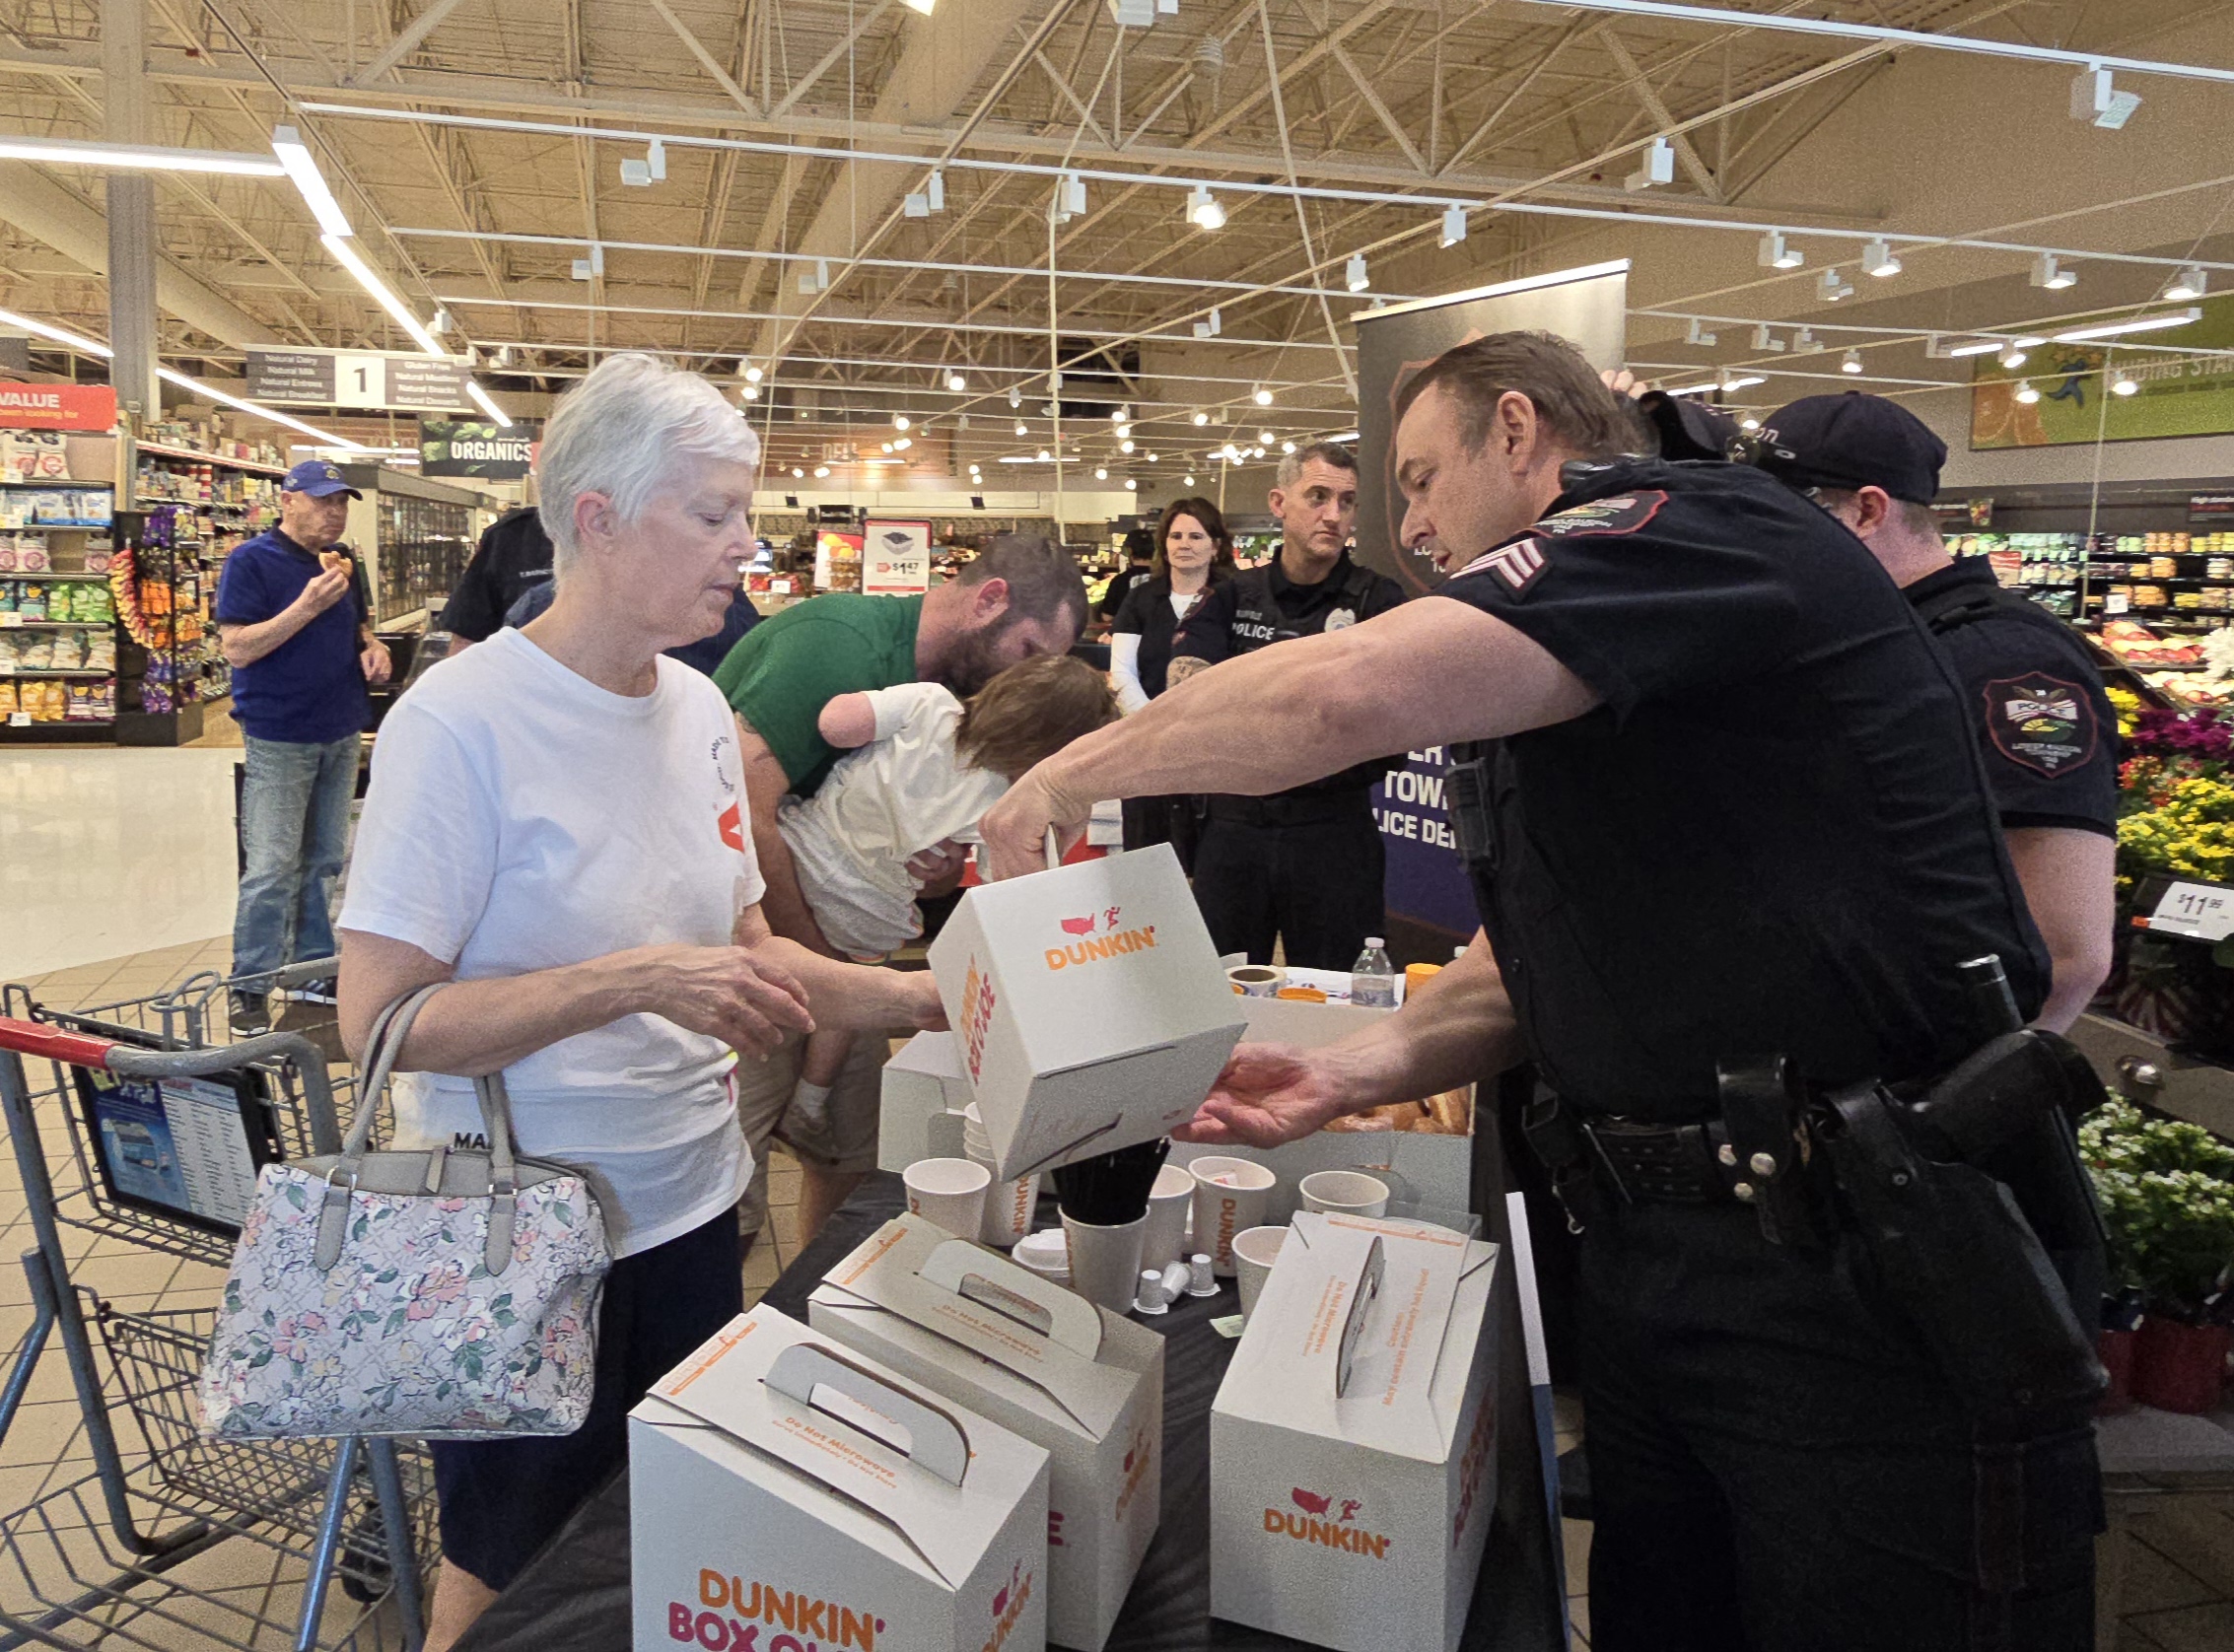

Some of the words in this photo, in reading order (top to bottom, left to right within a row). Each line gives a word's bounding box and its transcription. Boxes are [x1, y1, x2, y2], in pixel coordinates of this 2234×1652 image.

[0, 392, 60, 408] VALUE
[354, 368, 366, 392] 1
[451, 441, 532, 461] ORGANICS
[1384, 770, 1448, 810] TOW
[1422, 818, 1456, 850] DE
[1045, 925, 1155, 971] DUNKIN'
[786, 1417, 802, 1428] Do
[804, 1426, 826, 1441] Not
[829, 1439, 894, 1478] Microwave
[1264, 1508, 1391, 1560] DUNKIN'
[700, 1567, 885, 1652] DUNKIN'
